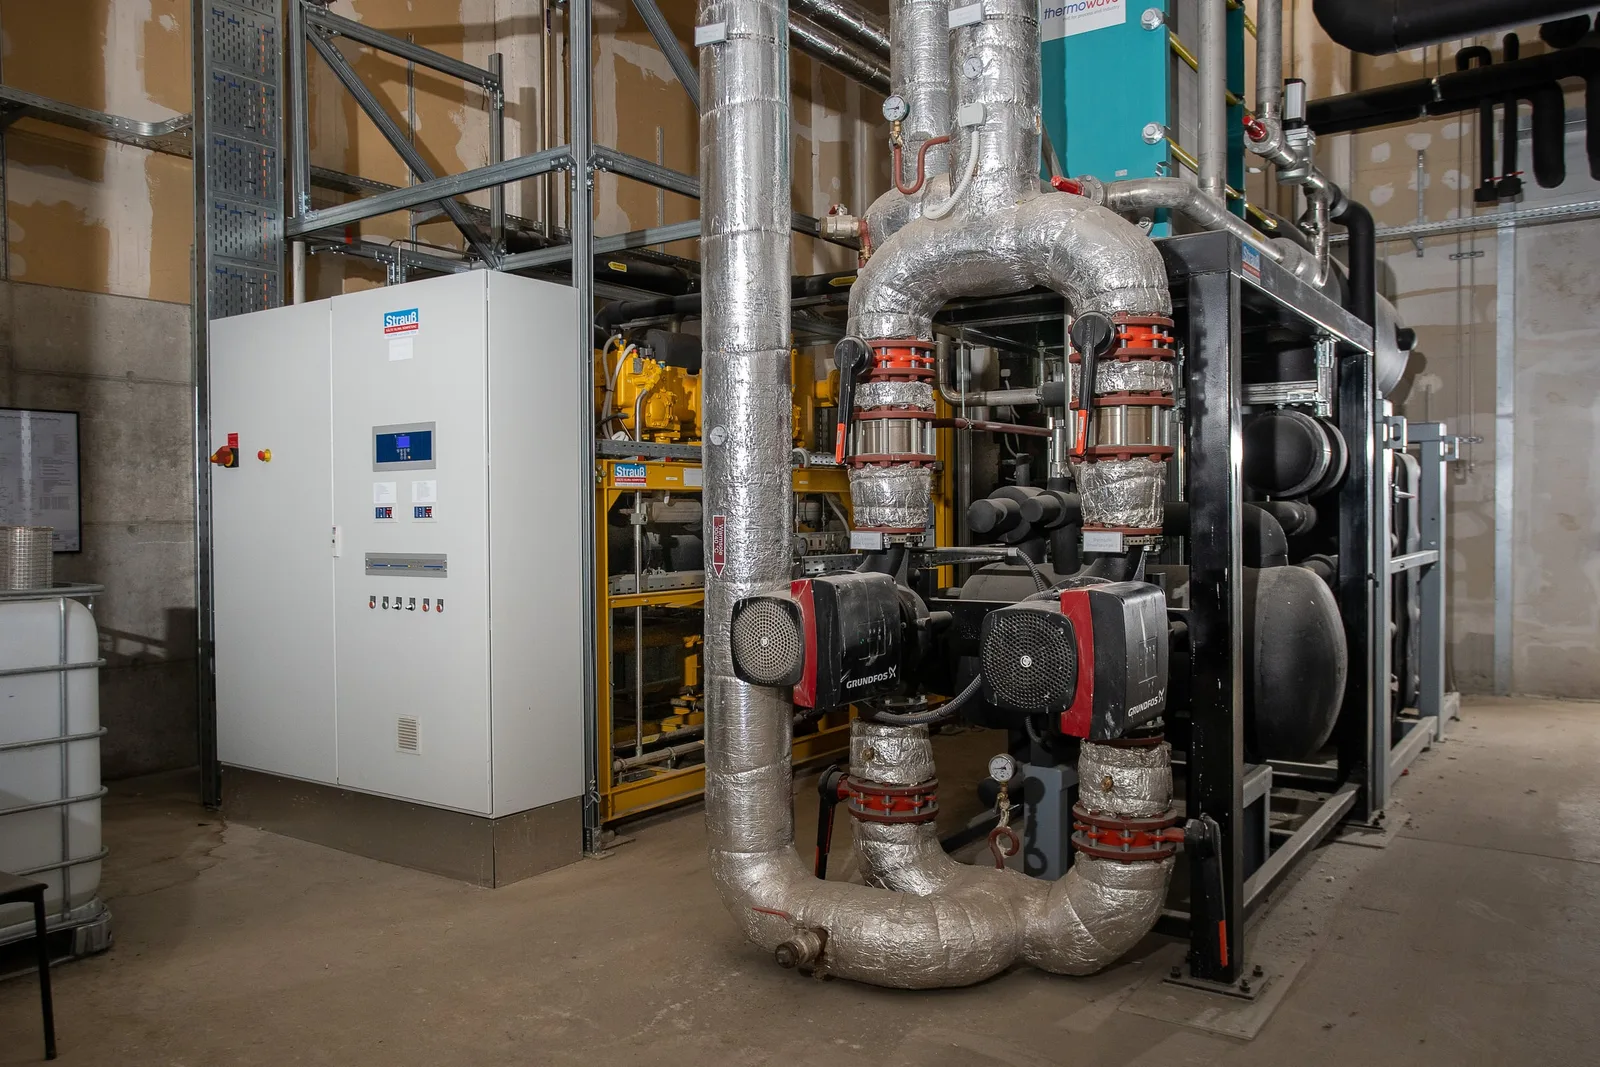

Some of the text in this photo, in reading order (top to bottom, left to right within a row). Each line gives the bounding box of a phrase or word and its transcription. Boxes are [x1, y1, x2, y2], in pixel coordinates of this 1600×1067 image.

[1044, 0, 1118, 19] thermowav
[386, 311, 417, 326] Strauß
[616, 465, 645, 477] Strauß
[846, 671, 888, 689] GRUNDFOS
[1128, 696, 1158, 717] GRUNDFOS
